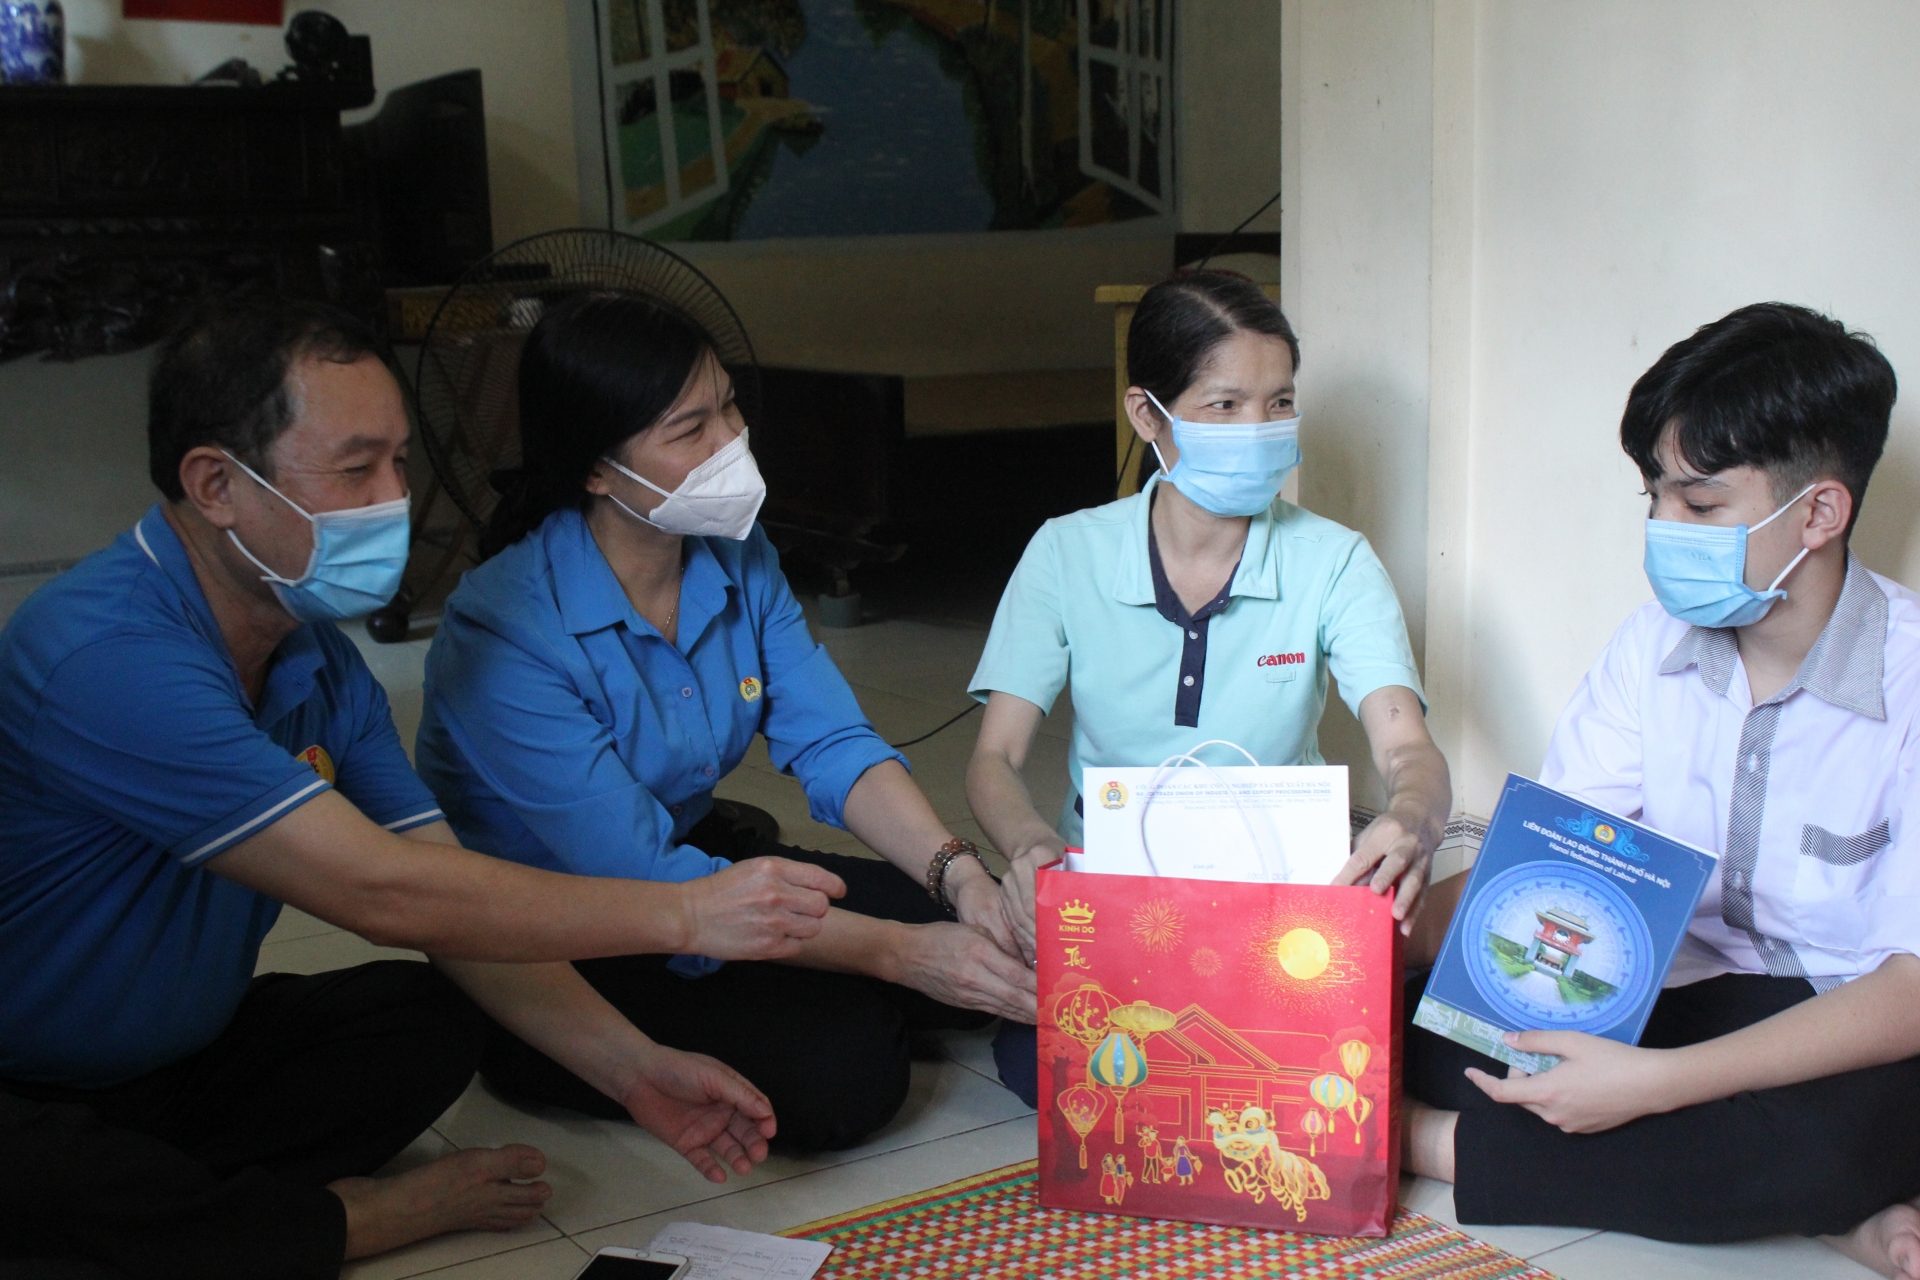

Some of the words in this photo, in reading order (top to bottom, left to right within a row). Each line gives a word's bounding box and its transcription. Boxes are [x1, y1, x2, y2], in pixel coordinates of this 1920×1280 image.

[1257, 652, 1306, 667] Canon
[1522, 819, 1541, 833] LIÊN
[1540, 828, 1562, 843] ĐOÀN
[1562, 836, 1578, 849] LAO
[1627, 862, 1645, 877] PHỐ
[1644, 871, 1656, 882] HÀ
[1656, 876, 1672, 889] NỘI
[1549, 841, 1571, 857] Hanoi
[1569, 849, 1605, 871] federation
[1604, 864, 1614, 874] of
[1612, 868, 1638, 884] Labour
[1059, 924, 1081, 932] KINH
[1082, 926, 1095, 934] DO
